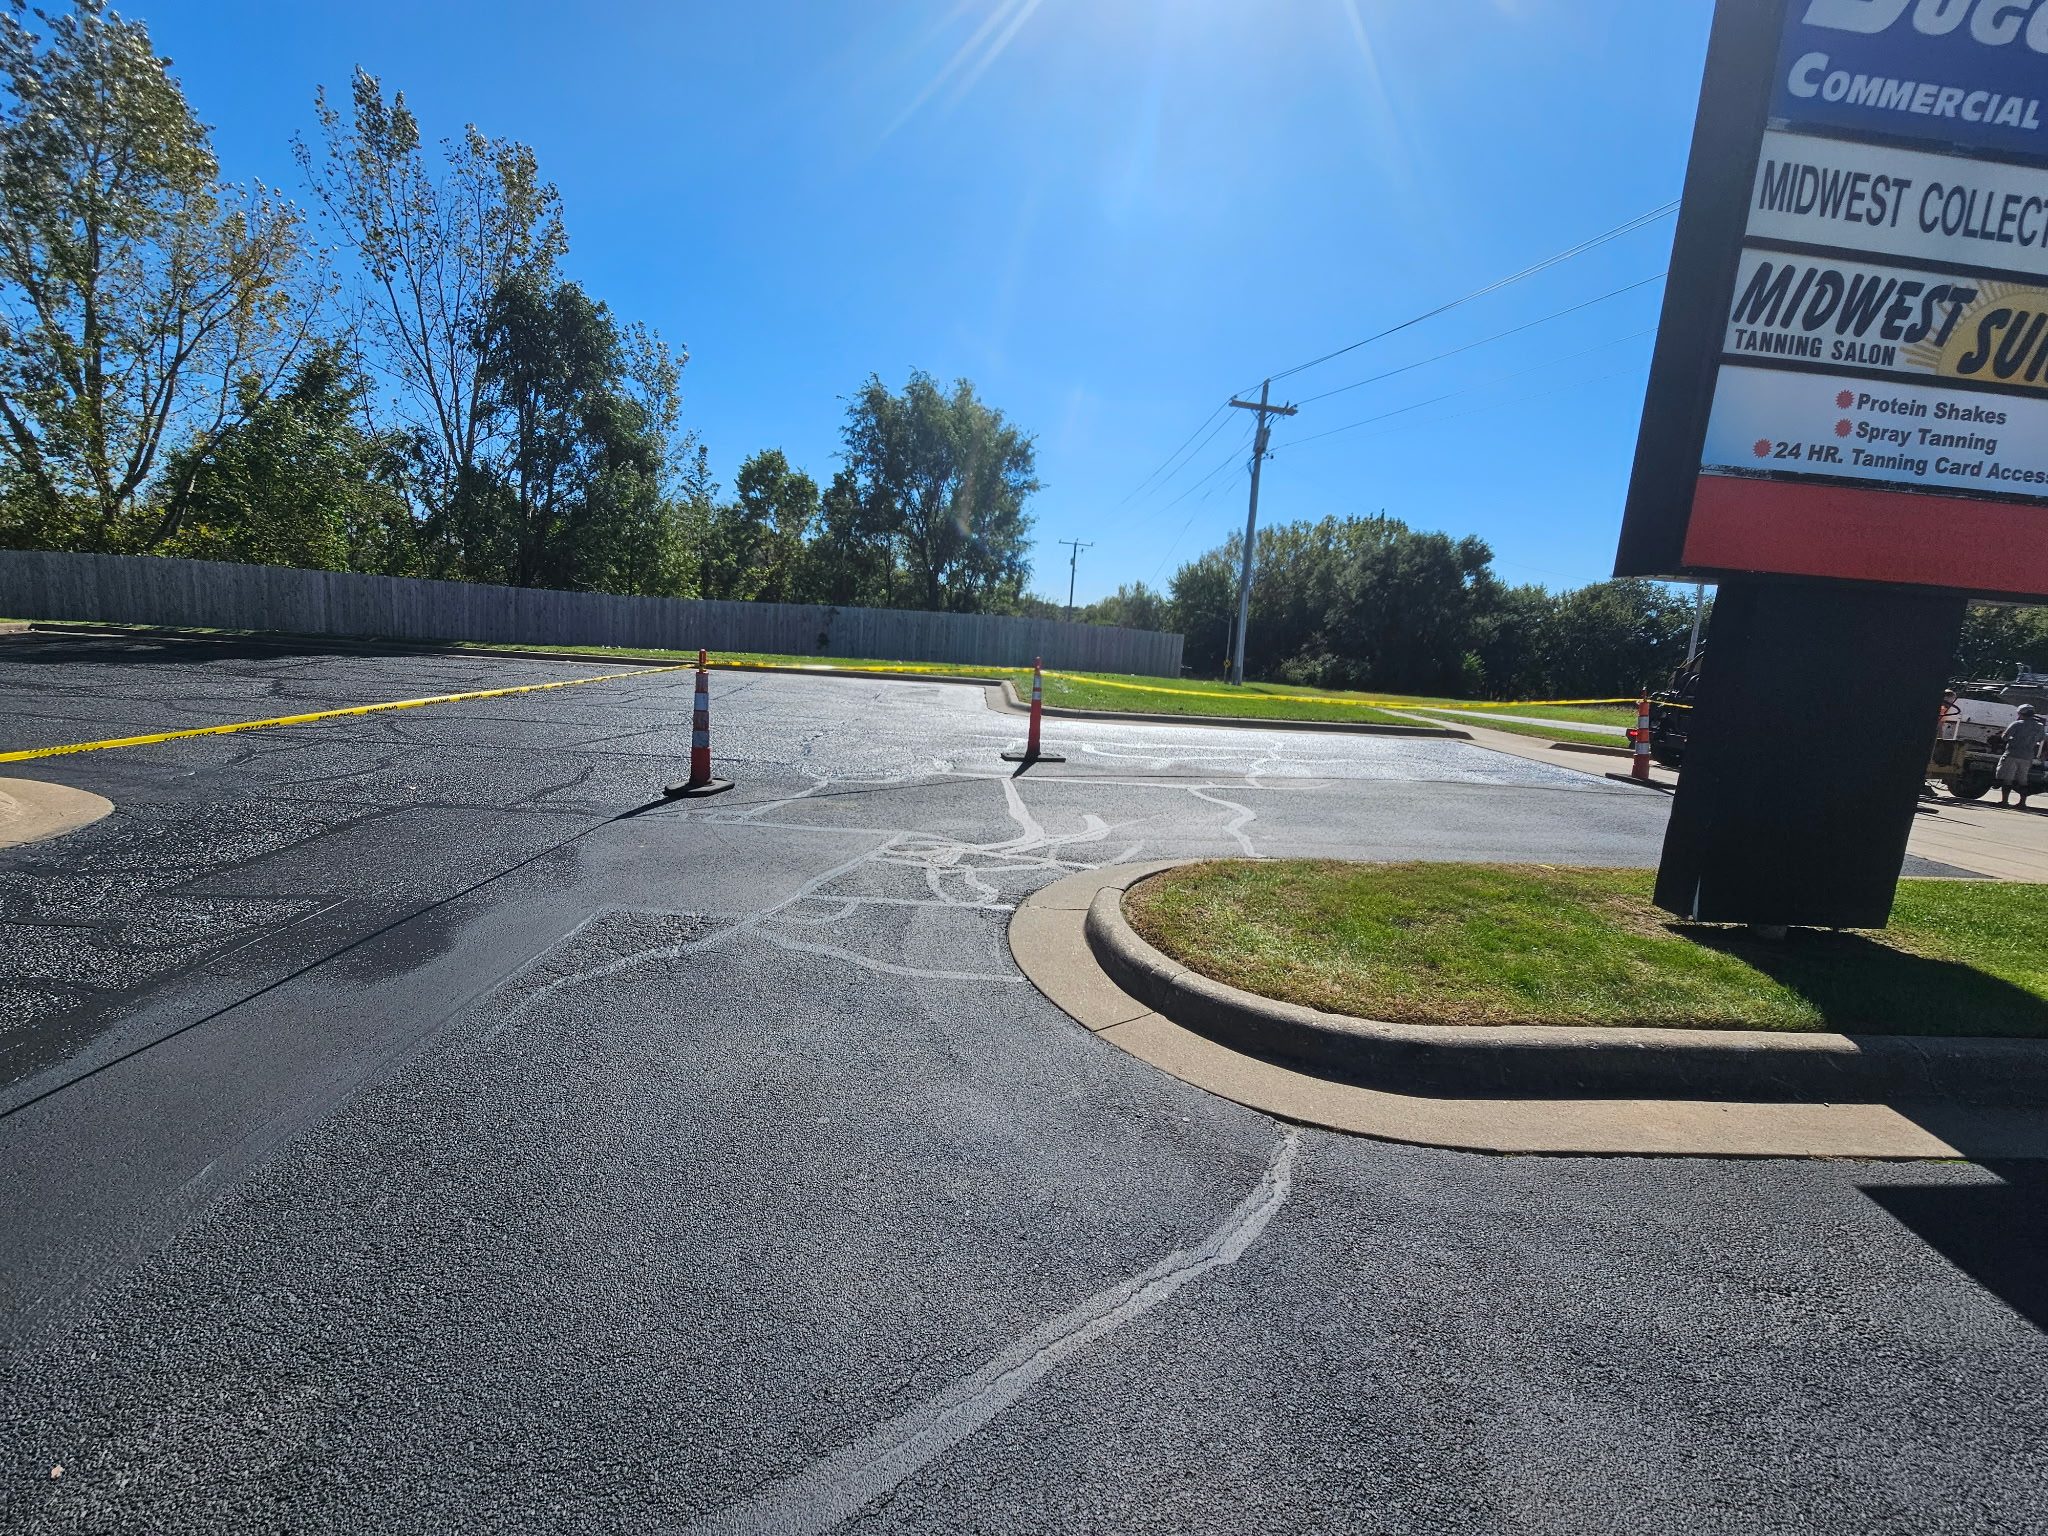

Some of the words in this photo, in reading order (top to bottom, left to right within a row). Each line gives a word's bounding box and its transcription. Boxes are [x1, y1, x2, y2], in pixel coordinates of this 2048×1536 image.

[1787, 52, 2040, 130] COMMERCIAL
[1758, 160, 1912, 228] MIDWEST
[1732, 262, 1979, 347] MIDWEST
[1735, 328, 1823, 358] TANNING
[1831, 340, 1896, 366] SALON
[1856, 393, 1927, 417] Protein
[1933, 402, 2007, 425] Shakes
[1855, 421, 1912, 447] Spray
[1918, 428, 1998, 455] Tanning
[1773, 442, 1802, 458] 24
[1807, 444, 1843, 463] HR.
[1852, 448, 1928, 476] Tanning
[1935, 457, 1984, 477] Card
[1985, 462, 2048, 484] Acces
